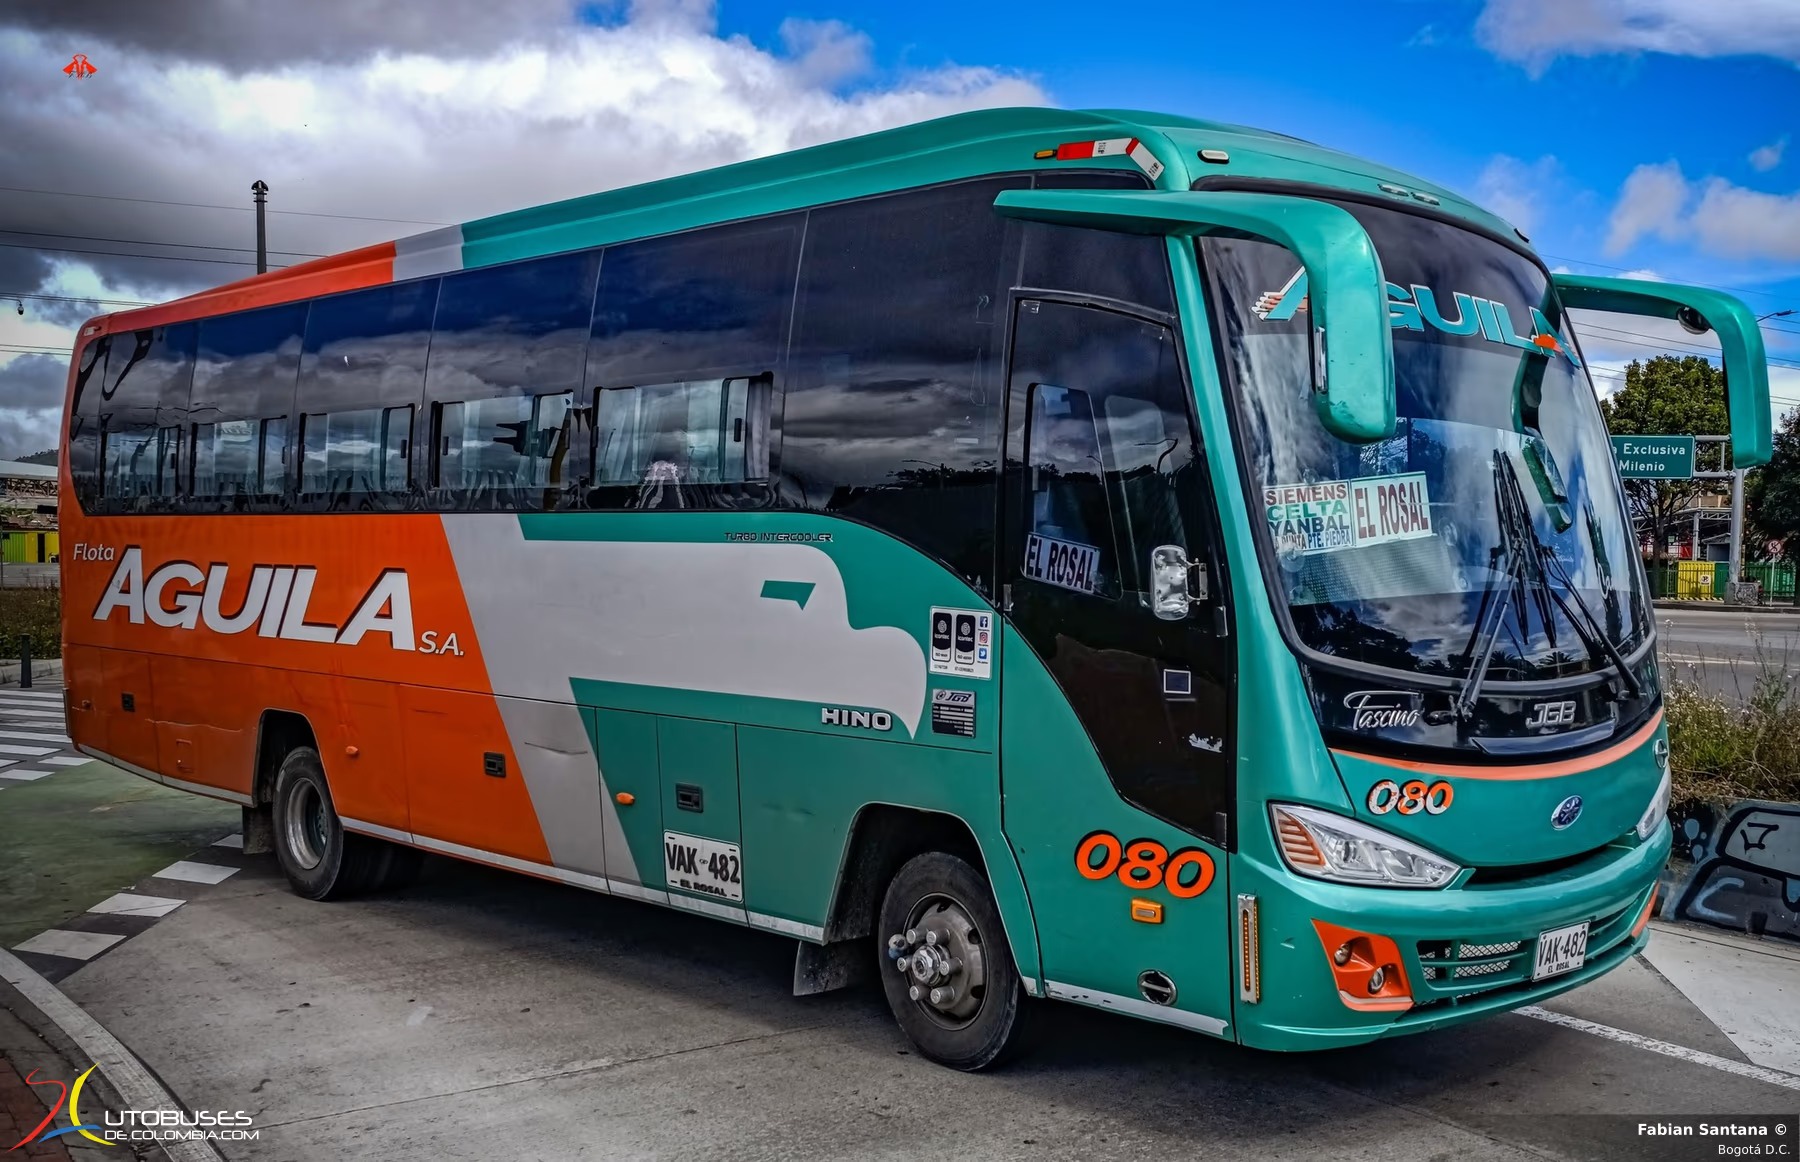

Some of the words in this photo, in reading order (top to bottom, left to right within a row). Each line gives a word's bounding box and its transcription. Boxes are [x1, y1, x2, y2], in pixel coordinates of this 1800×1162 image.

[1623, 443, 1686, 456] Exclusiva
[1265, 484, 1347, 506] SIEMENS
[1267, 500, 1348, 521] CELTA
[1354, 487, 1376, 539] EL
[1377, 481, 1429, 537] ROSAL
[1268, 515, 1350, 537] YANBAL
[1325, 528, 1350, 547] PIEDRA
[73, 543, 115, 562] Flota
[1027, 535, 1043, 578] EL
[1049, 541, 1094, 592] ROSAL
[93, 544, 416, 651] AGUILA
[418, 630, 465, 657] S.A.
[821, 707, 892, 731] HINO
[1367, 778, 1454, 816] 080
[1074, 829, 1217, 899] 080
